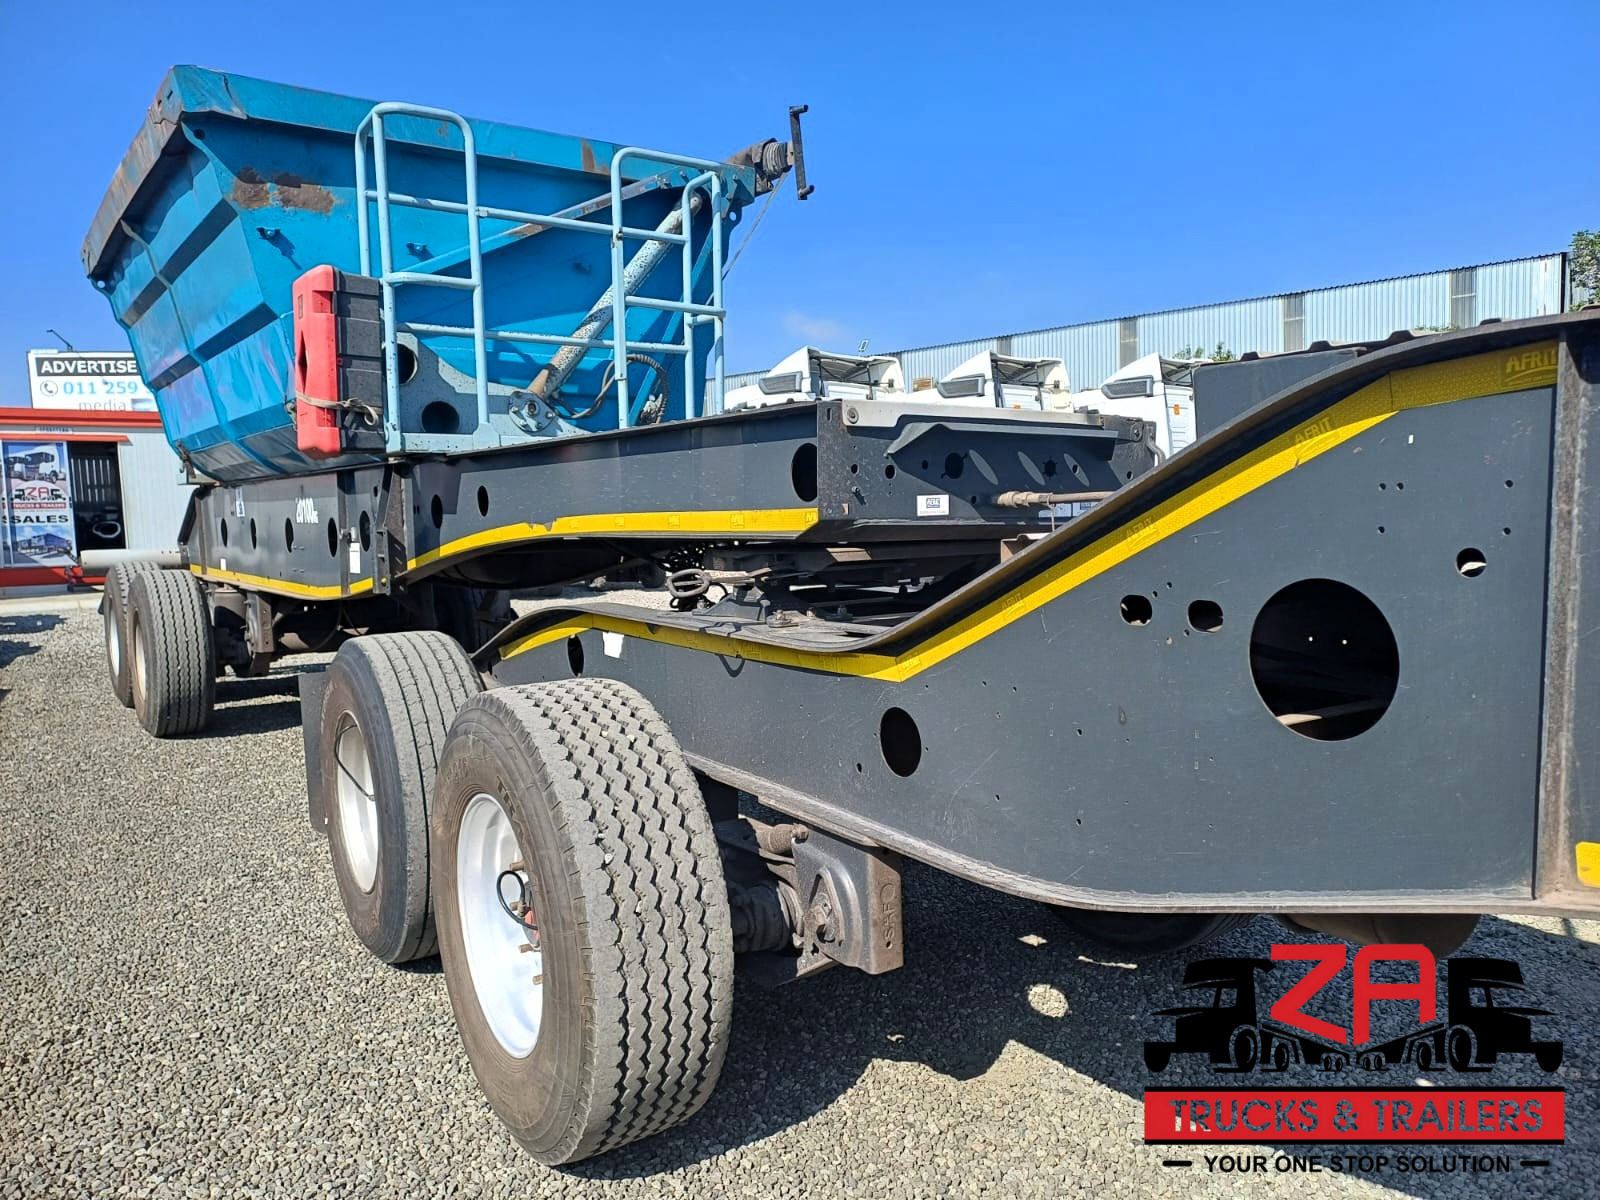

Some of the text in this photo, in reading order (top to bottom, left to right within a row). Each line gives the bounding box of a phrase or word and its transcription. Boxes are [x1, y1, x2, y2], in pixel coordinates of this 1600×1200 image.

[41, 360, 138, 374] ADVERTISE
[63, 381, 97, 395] 011
[105, 380, 138, 395] 259
[78, 398, 127, 412] media
[10, 514, 69, 524] SALES
